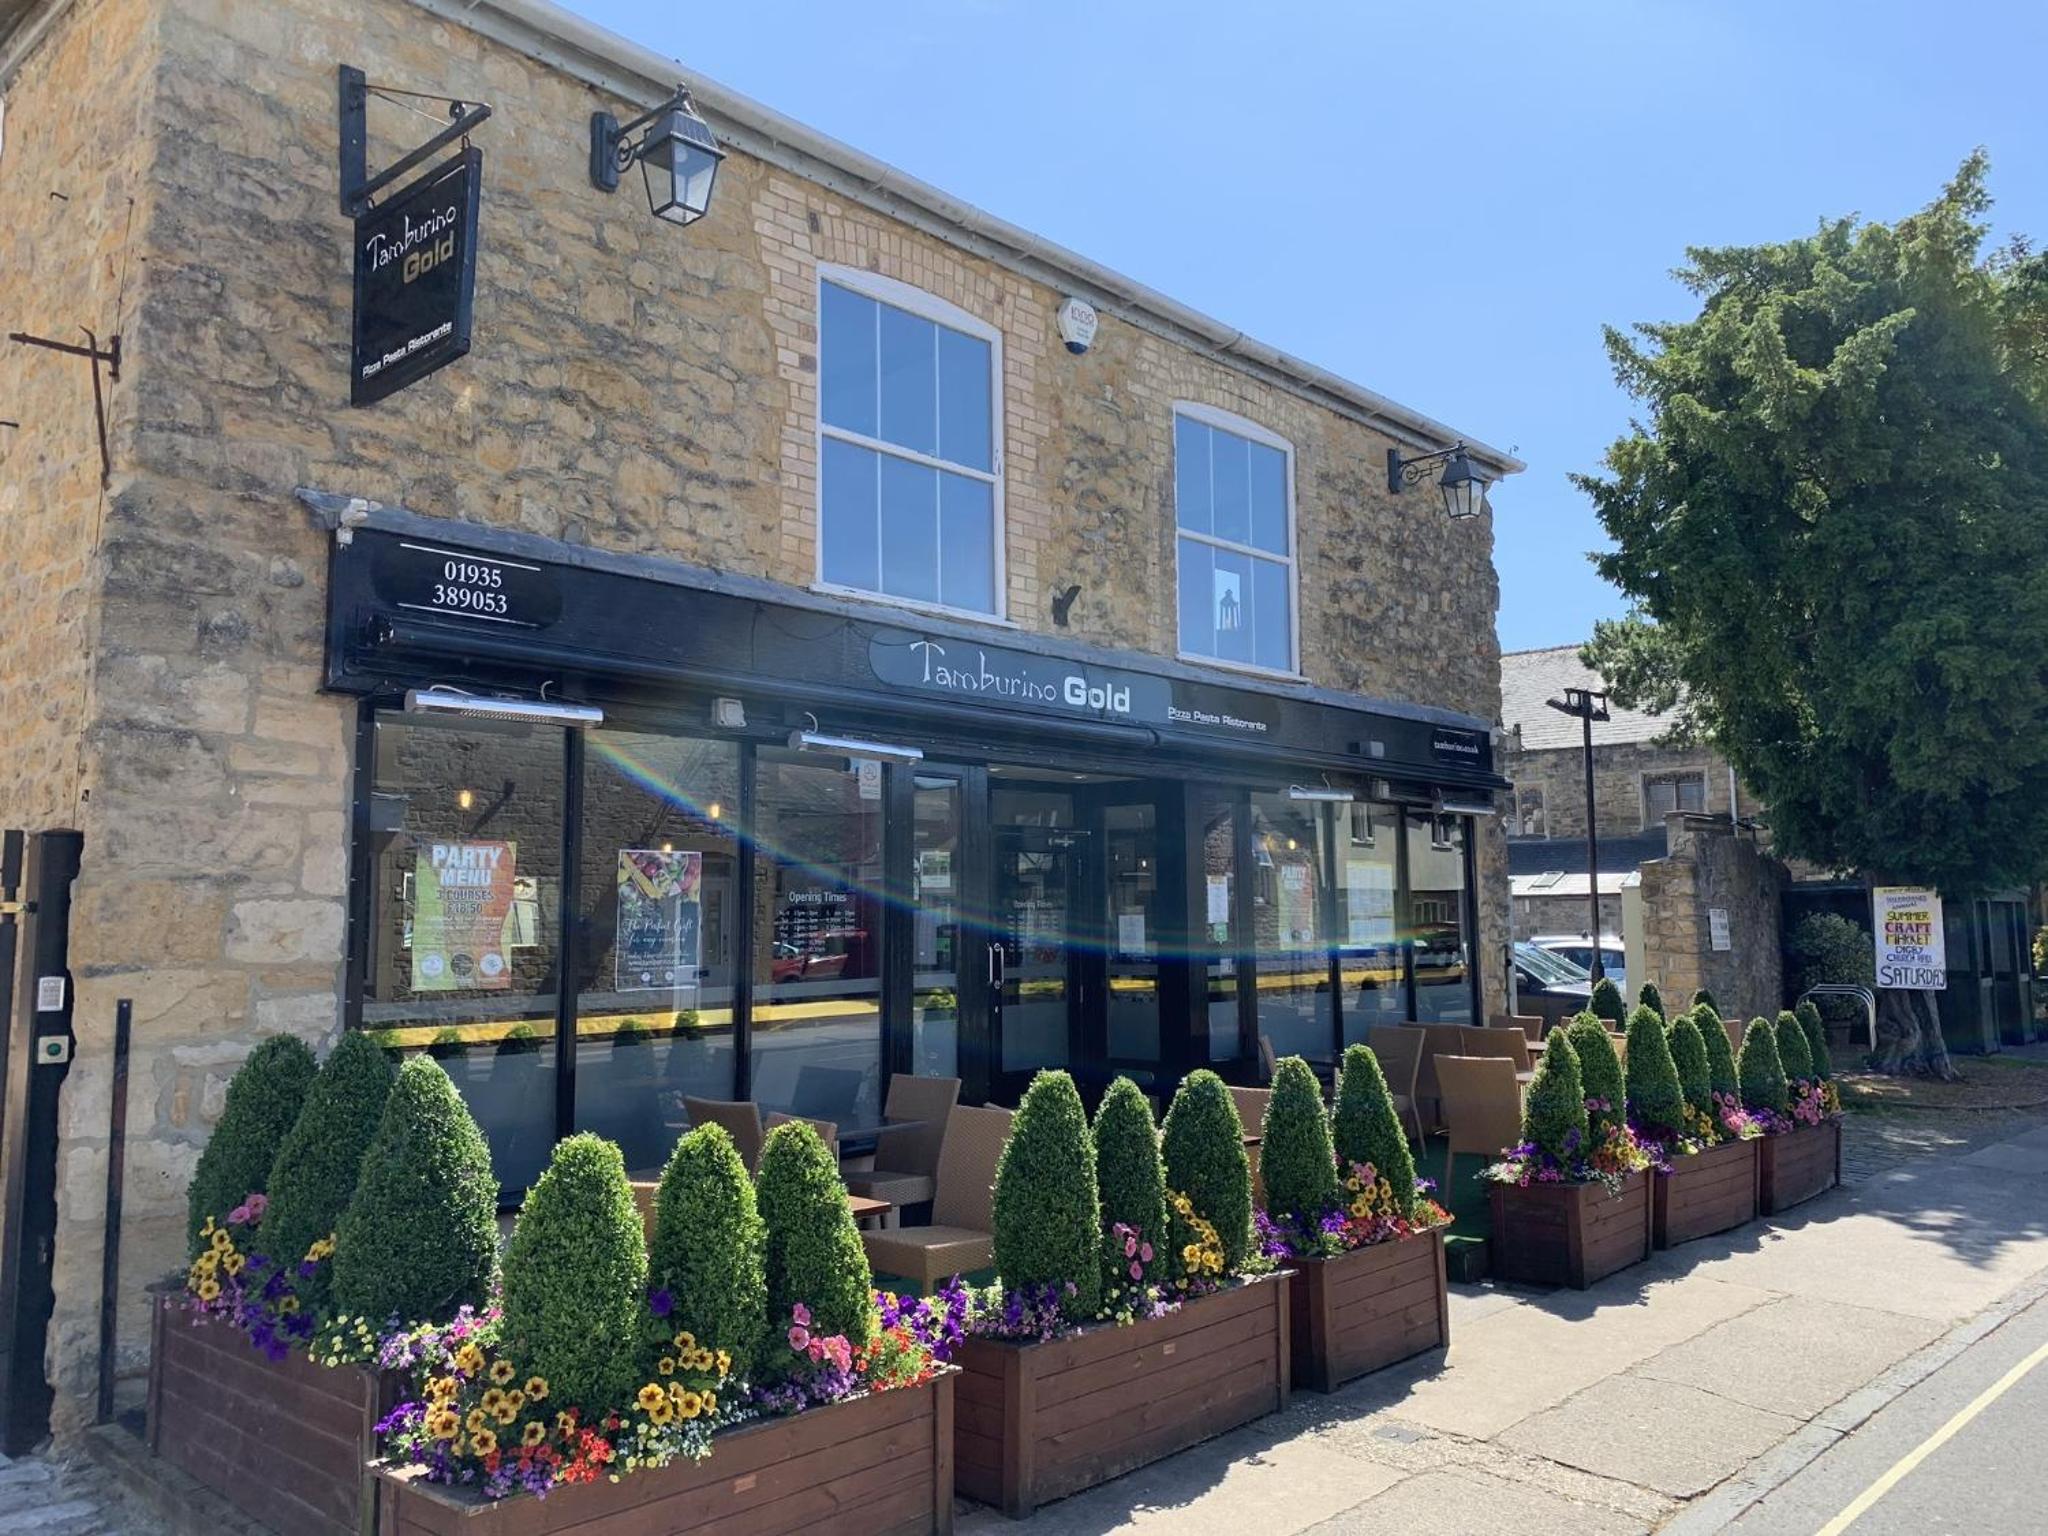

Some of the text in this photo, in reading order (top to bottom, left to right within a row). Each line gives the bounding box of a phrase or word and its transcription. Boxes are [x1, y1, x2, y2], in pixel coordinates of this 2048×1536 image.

[366, 206, 457, 272] Tamburino
[403, 230, 455, 284] Gold
[362, 321, 453, 378] Pizza Pasta Ristorante
[444, 561, 502, 588] 01935
[432, 584, 507, 613] 389053
[910, 641, 1131, 713] Tamburino Gold
[1168, 706, 1267, 731] Pizza Pasta Ristorante
[432, 845, 504, 869] PARTY
[440, 868, 493, 887] MENU
[446, 887, 494, 900] COURSES
[788, 891, 848, 904] Opening Times
[1885, 922, 1932, 933] CRAFT
[1887, 911, 1930, 921] SUMMER
[1880, 965, 1946, 987] SATURDAY
